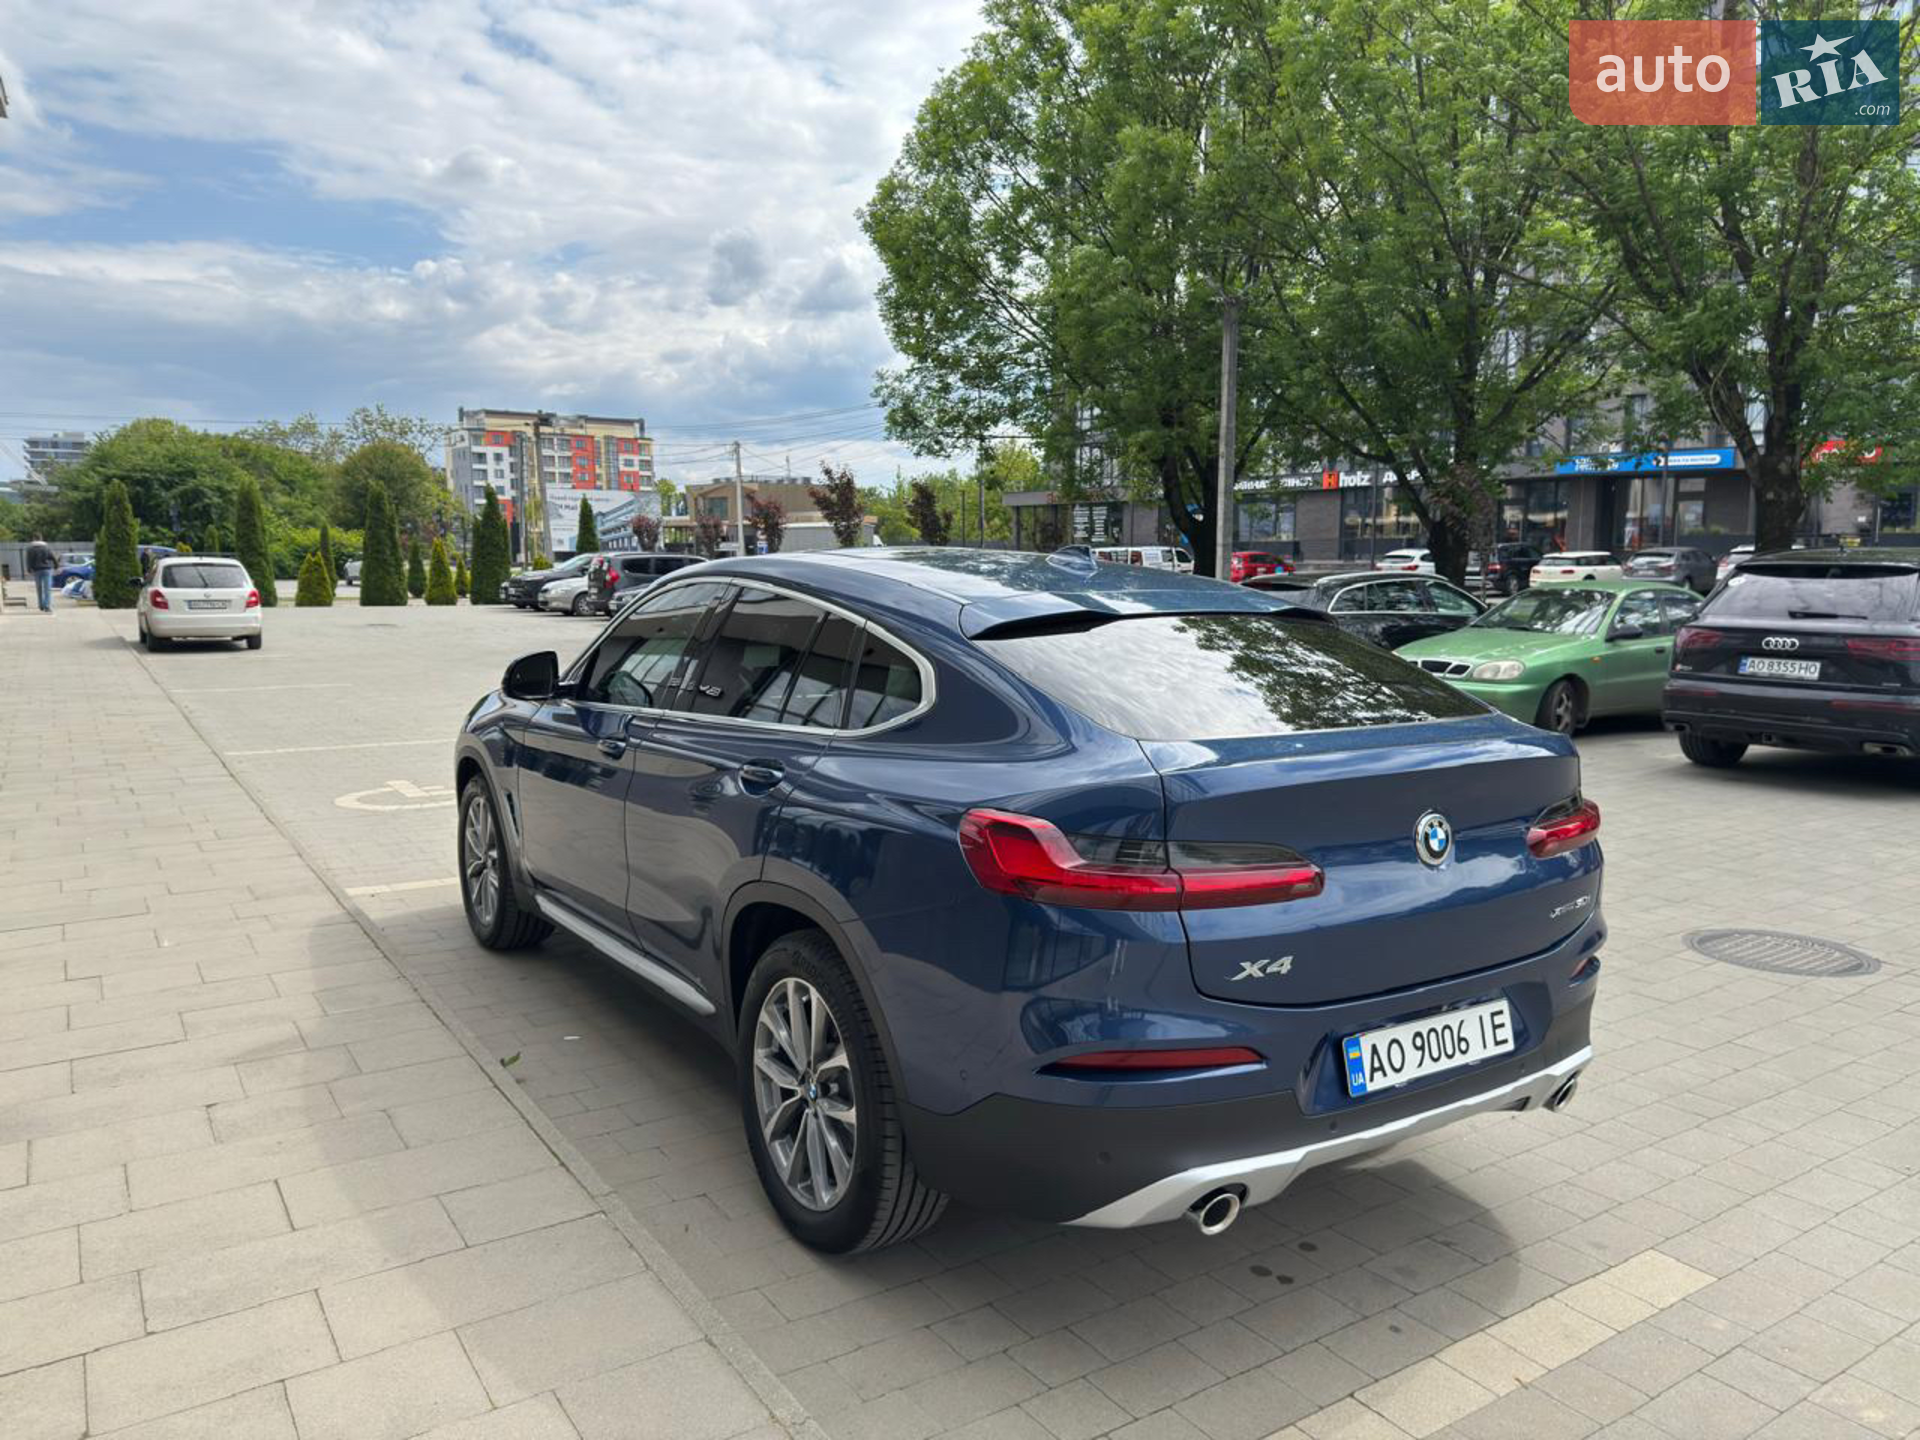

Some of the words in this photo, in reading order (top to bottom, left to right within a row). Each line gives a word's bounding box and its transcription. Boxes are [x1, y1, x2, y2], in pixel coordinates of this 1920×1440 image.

[1339, 471, 1371, 487] holz
[1748, 660, 1766, 671] AO
[1766, 661, 1796, 673] 8355
[1799, 662, 1818, 674] HO
[1230, 955, 1294, 981] X4
[1369, 1038, 1405, 1082] AO
[1412, 1020, 1470, 1068] 9006
[1479, 1009, 1509, 1050] IE
[1352, 1072, 1365, 1086] UA
